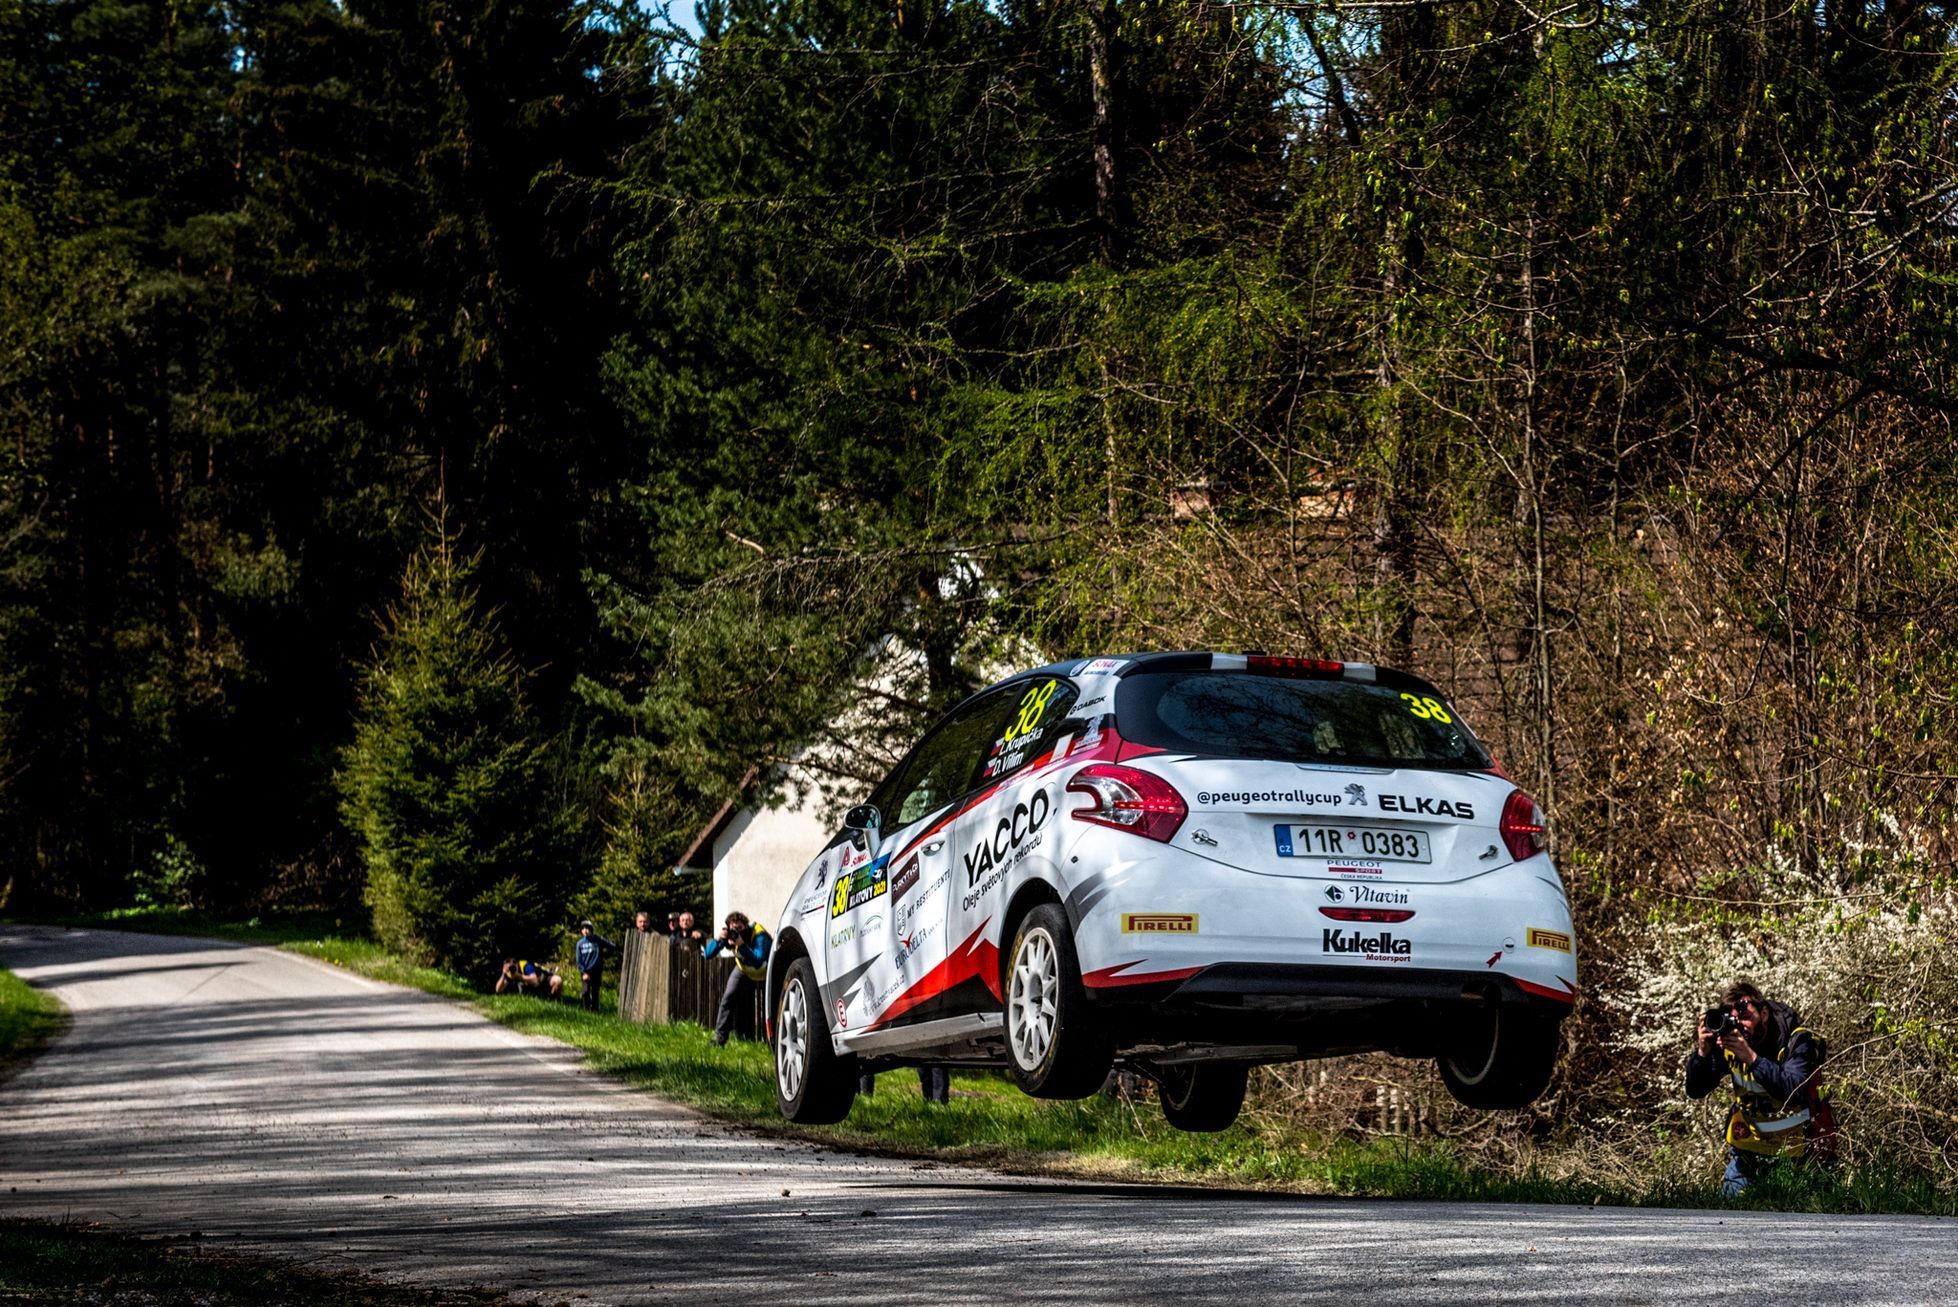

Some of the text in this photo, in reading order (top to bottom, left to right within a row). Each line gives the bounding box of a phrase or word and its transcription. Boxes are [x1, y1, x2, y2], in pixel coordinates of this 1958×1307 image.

[1004, 679, 1057, 742] 38
[1400, 693, 1452, 724] 38
[1197, 790, 1342, 806] @peugeotrallycup
[1377, 794, 1475, 820] ELKAS
[964, 788, 1049, 889] YACCO
[1279, 845, 1291, 853] CZ
[1299, 829, 1419, 858] 11R 0383
[963, 832, 1043, 911] Oleje světových rekordů
[832, 875, 850, 917] 38
[850, 885, 873, 907] KLATOVY
[874, 880, 886, 897] 2021
[1128, 916, 1193, 931] PIRELLI
[1323, 929, 1411, 954] Kukelka
[1531, 930, 1570, 951] PIRELLI
[1366, 954, 1411, 962] Motorsport
